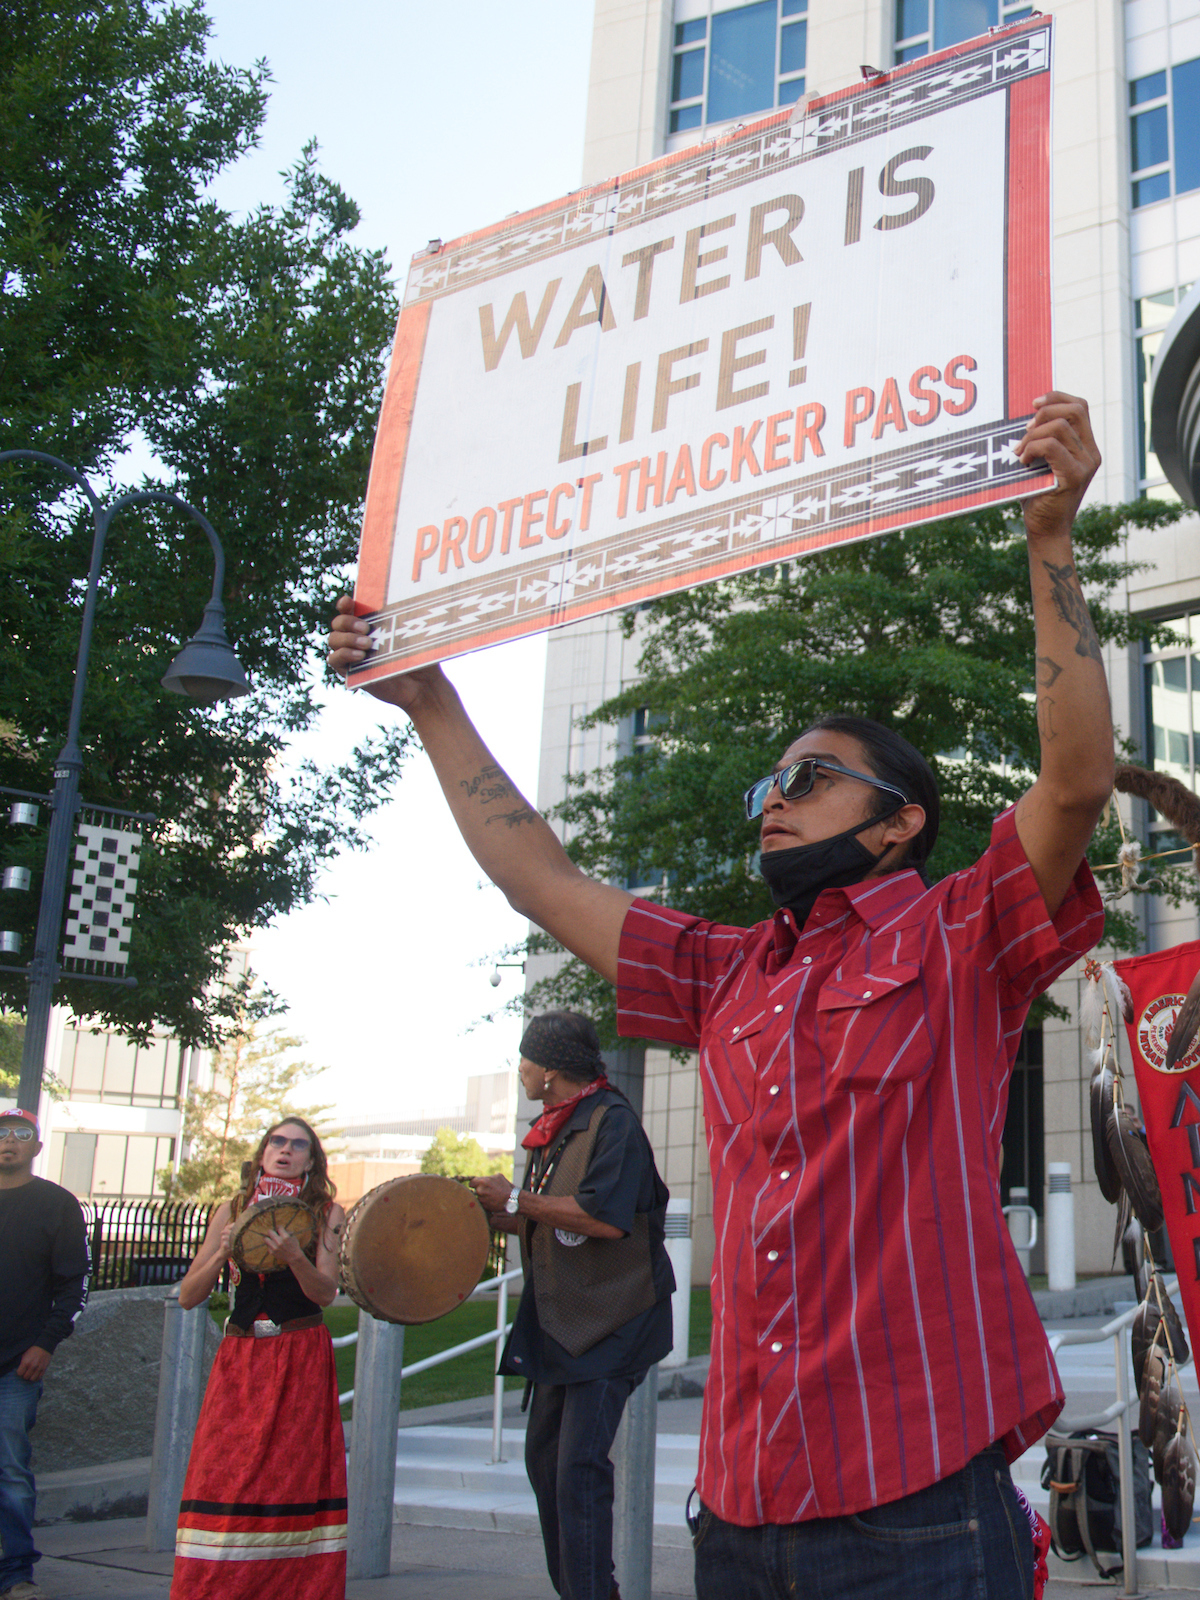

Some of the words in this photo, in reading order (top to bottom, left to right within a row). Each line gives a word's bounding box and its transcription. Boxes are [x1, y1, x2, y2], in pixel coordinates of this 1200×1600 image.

[477, 193, 806, 373] WATER
[844, 145, 936, 246] IS
[557, 302, 813, 464] LIFE!
[412, 473, 603, 582] PROTECT
[613, 401, 826, 520] THACKER
[843, 354, 978, 448] PASS
[1140, 1030, 1164, 1068] INDIAN
[1144, 996, 1184, 1024] AMERIC
